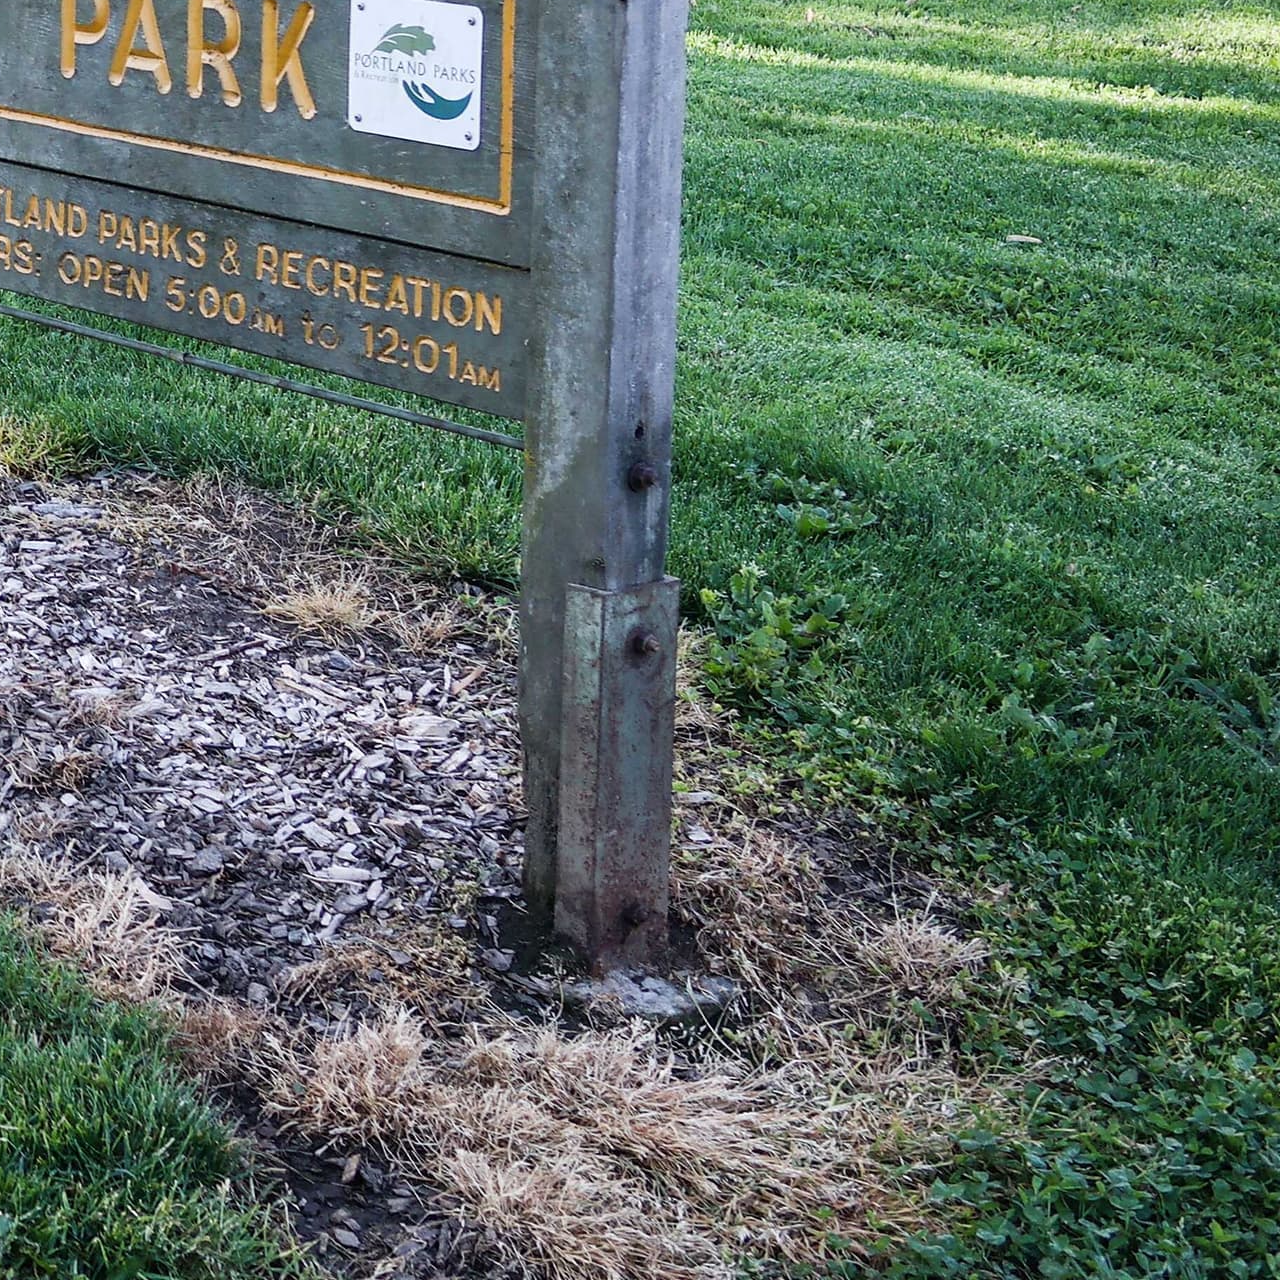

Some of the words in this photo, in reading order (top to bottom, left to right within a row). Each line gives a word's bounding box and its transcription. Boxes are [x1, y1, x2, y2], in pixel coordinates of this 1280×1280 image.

[353, 52, 427, 77] PORTLAND
[433, 64, 476, 84] PARKS
[57, 250, 150, 303] OPEN
[98, 208, 208, 269] PARKS
[219, 236, 241, 276] &
[255, 242, 504, 336] RECREATION
